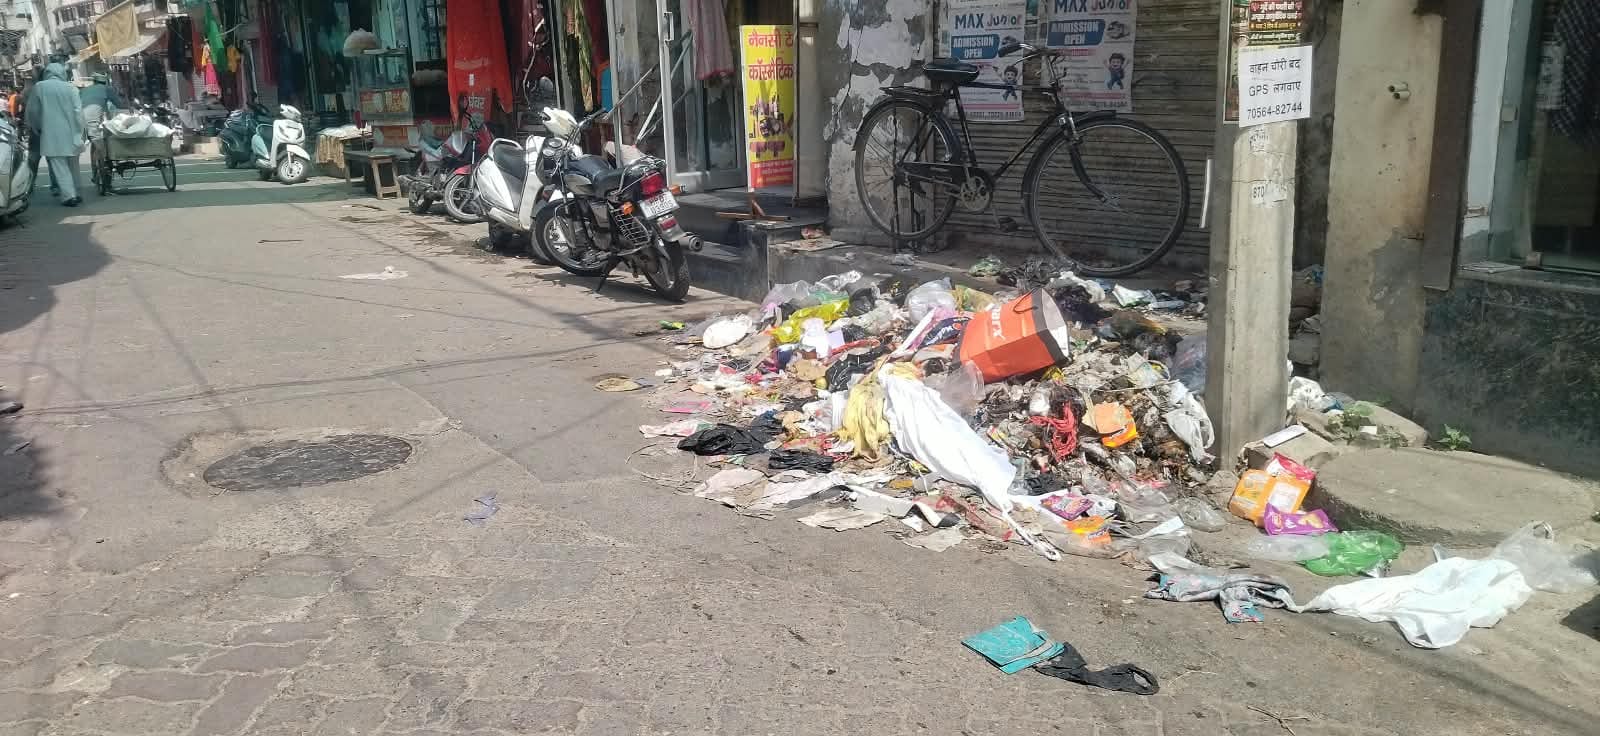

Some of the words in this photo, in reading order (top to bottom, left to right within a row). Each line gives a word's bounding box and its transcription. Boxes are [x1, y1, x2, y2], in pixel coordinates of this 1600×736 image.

[1055, 0, 1087, 13] MAX
[955, 13, 984, 29] MAX
[987, 13, 1022, 27] Junior
[1051, 20, 1099, 32] ADMISSION
[953, 36, 993, 48] ADMISSION
[1064, 33, 1086, 45] OPEN
[964, 48, 983, 58] OPEN
[1249, 63, 1268, 74] वाहन
[1249, 84, 1268, 97] GPS
[1247, 102, 1302, 120] 70564-82744
